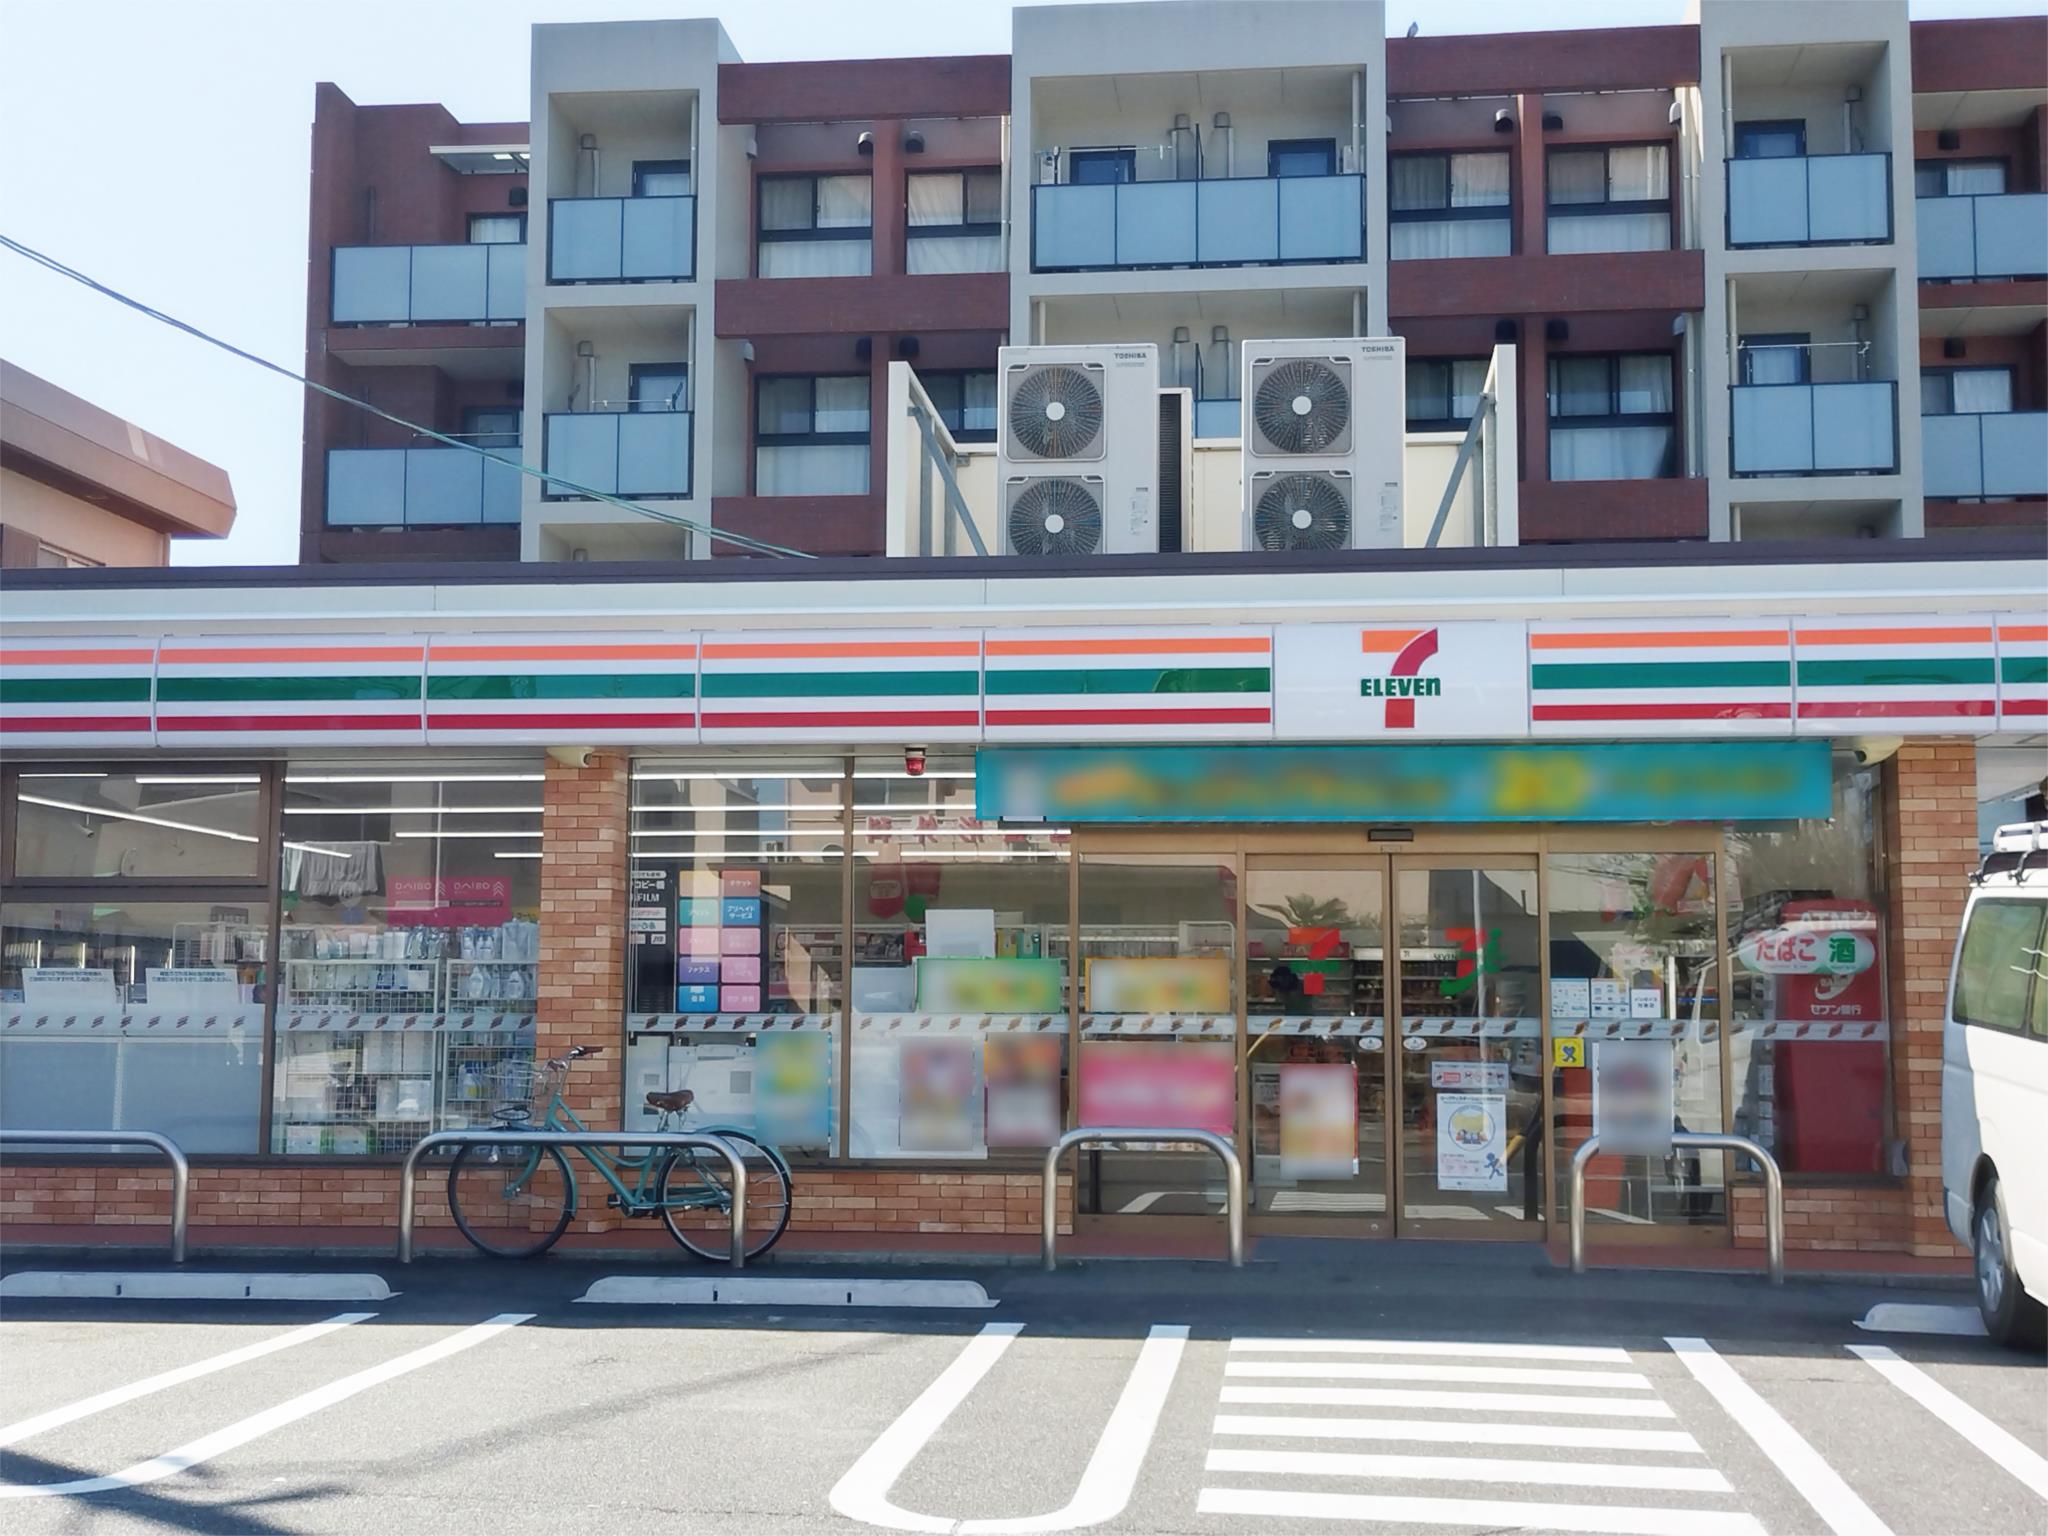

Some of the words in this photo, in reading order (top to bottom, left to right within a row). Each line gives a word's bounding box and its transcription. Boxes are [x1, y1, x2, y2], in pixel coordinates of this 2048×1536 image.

[1755, 936, 1817, 962] たばこ
[1829, 937, 1857, 964] 酒
